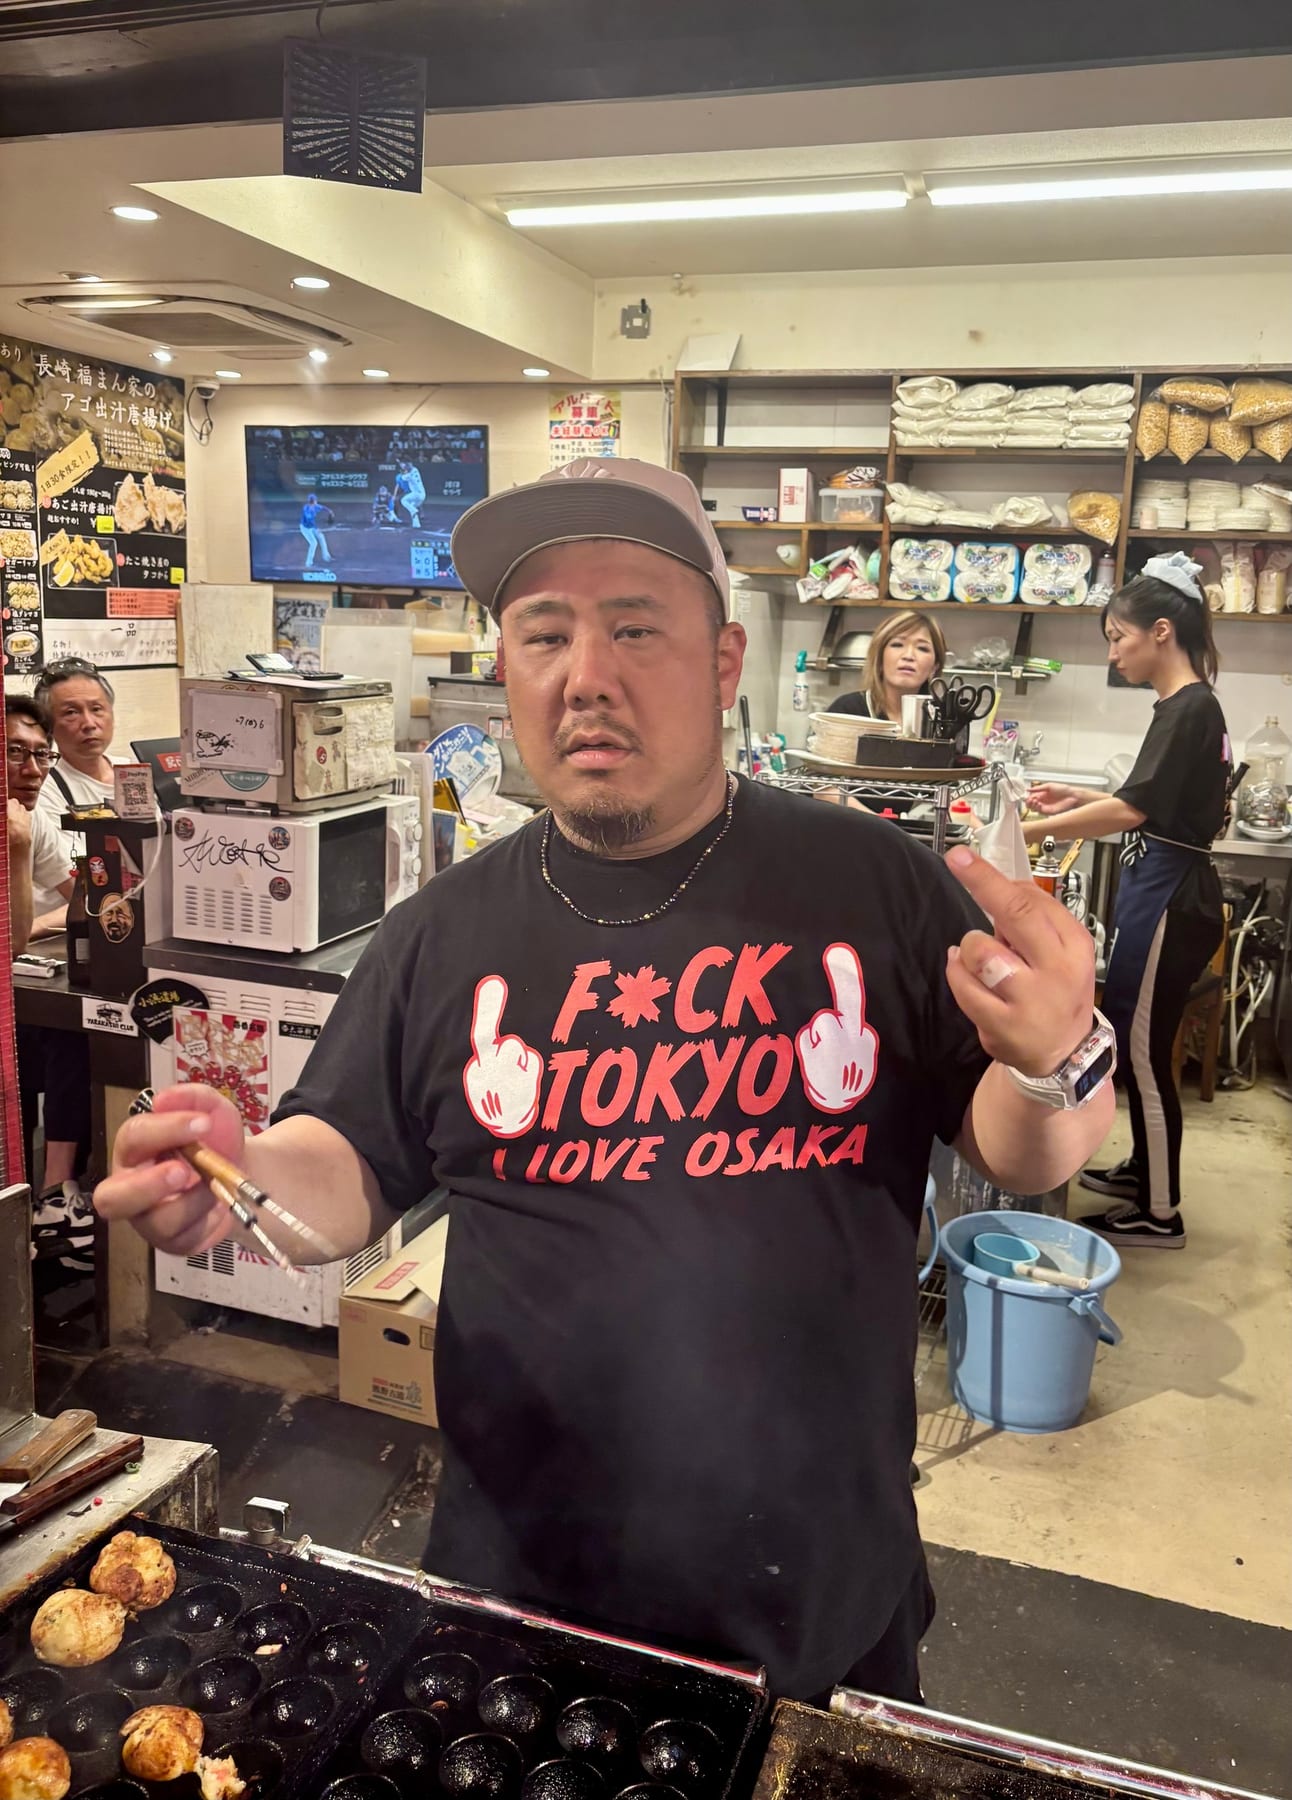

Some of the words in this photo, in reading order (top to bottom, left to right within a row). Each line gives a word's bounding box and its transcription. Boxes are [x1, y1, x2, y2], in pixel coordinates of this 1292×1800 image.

[35, 353, 156, 398] 長崎福まん家の
[61, 393, 172, 432] アゴ出汁唐揚げ
[110, 622, 137, 637] 一品
[541, 1034, 794, 1131] TOKYO
[526, 1135, 665, 1184] LOVE
[685, 1124, 868, 1178] OSAKA
